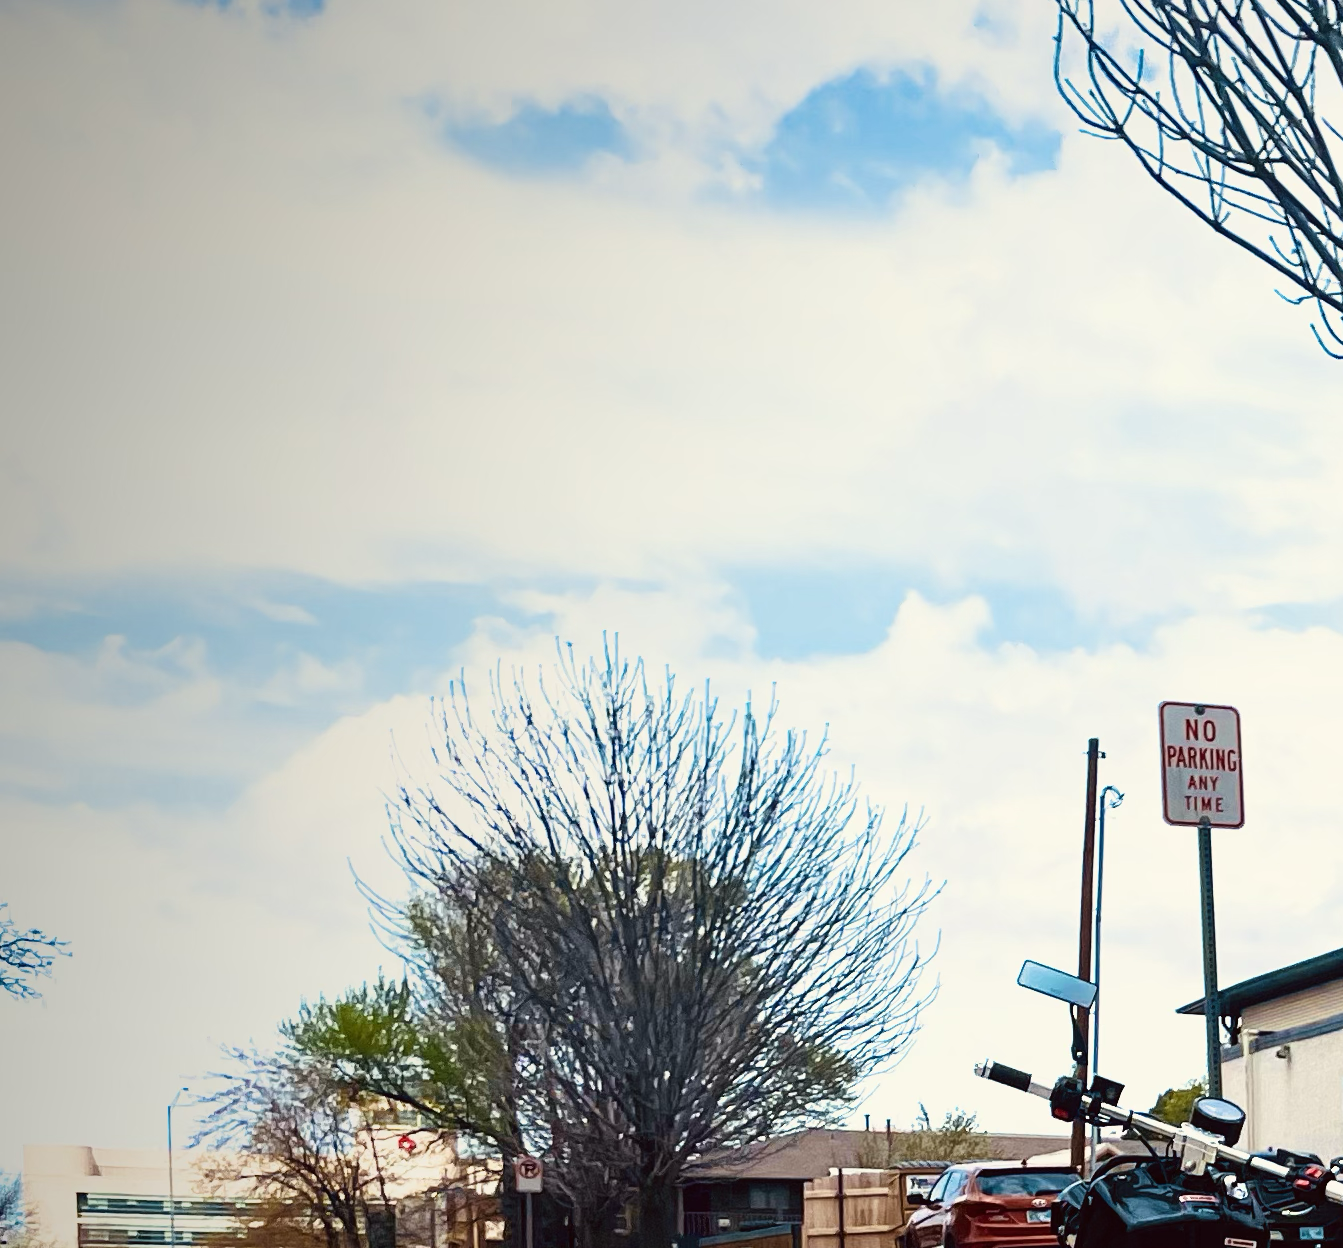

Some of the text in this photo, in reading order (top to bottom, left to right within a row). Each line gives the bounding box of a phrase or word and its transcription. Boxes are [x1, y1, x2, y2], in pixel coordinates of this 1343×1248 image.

[1185, 719, 1217, 742] NO
[1167, 745, 1238, 772] PARKING
[1187, 775, 1220, 792] ANY
[1184, 795, 1224, 812] TIME
